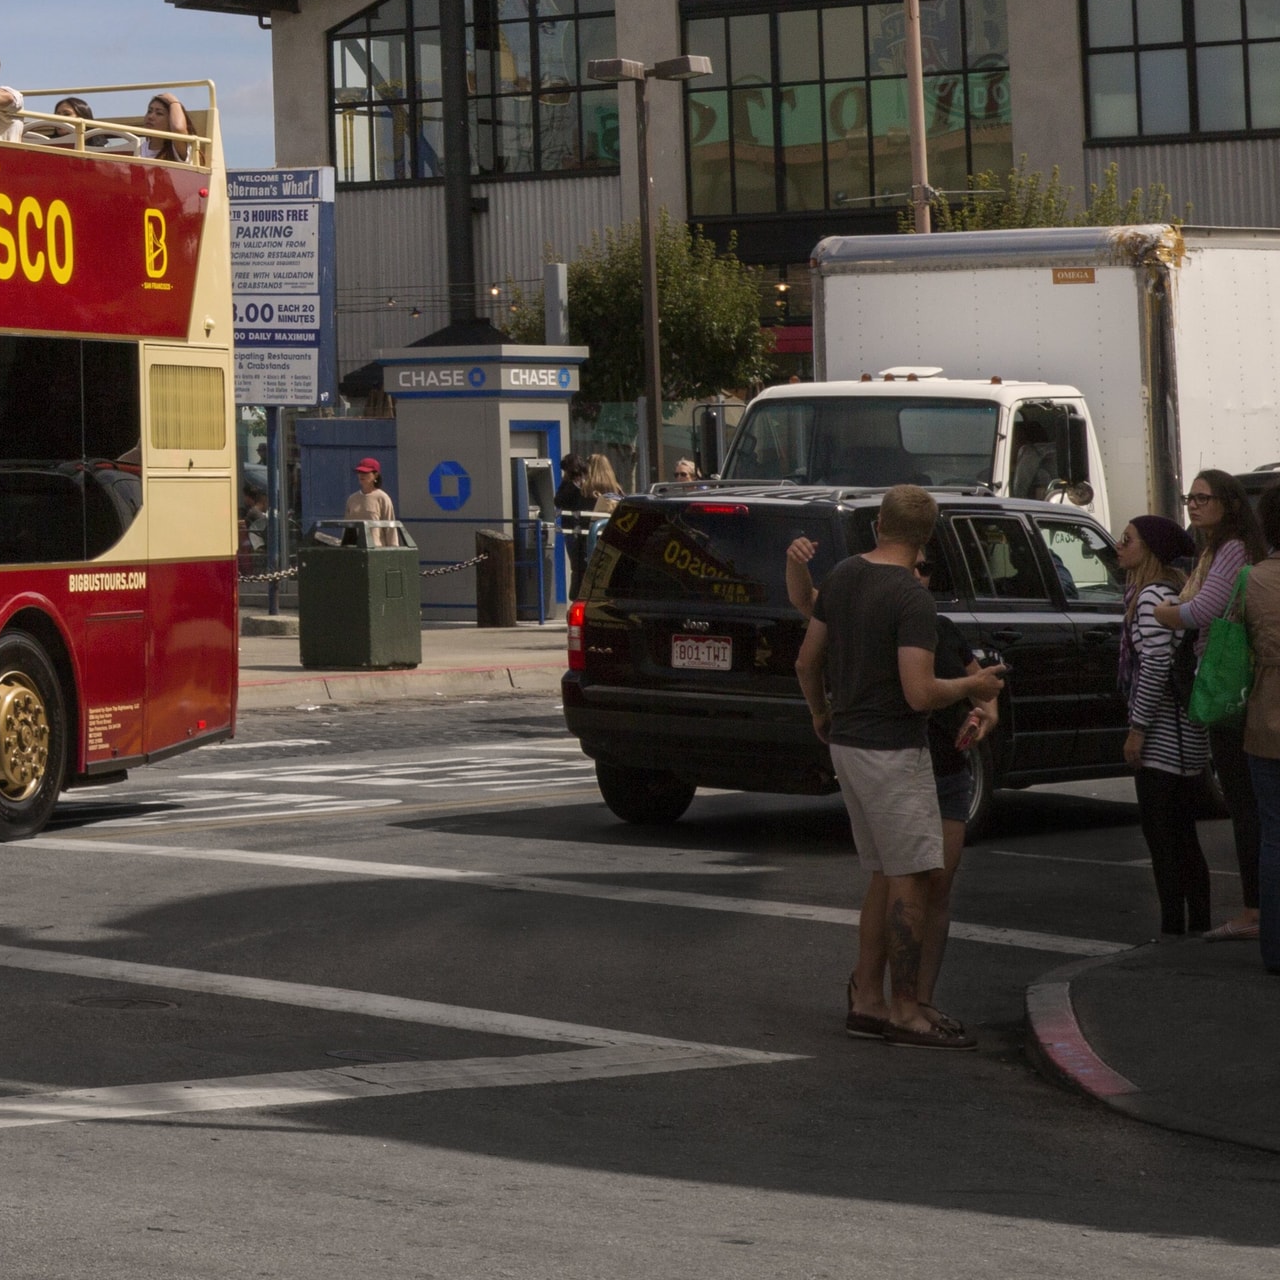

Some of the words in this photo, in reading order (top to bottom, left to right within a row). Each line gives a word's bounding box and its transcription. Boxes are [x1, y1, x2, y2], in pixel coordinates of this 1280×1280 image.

[237, 174, 279, 182] WELCOME
[283, 173, 294, 181] TO
[282, 174, 314, 196] Wharf
[243, 210, 250, 222] 3
[251, 209, 284, 222] HOURS
[286, 209, 309, 221] FREE
[236, 225, 294, 239] PARKING
[243, 241, 283, 249] VALIDATION
[285, 240, 306, 248] FROM
[267, 251, 315, 259] RESTAURANTS
[273, 271, 314, 279] VALIDATION
[1057, 271, 1089, 279] OMEGA
[237, 281, 283, 289] CRABSTANDS
[278, 304, 300, 313] EACH
[302, 304, 315, 312] 20
[278, 314, 315, 323] MINUTES
[248, 332, 272, 340] DAILY
[274, 333, 316, 341] MAXIMUM
[267, 352, 312, 360] Restaurants
[238, 362, 243, 370] &
[247, 362, 290, 370] Crabstands
[398, 369, 465, 387] CHASE
[509, 368, 558, 386] CHASE
[68, 571, 146, 592] BIGBUSTOURS.COM
[683, 618, 710, 632] Jeep
